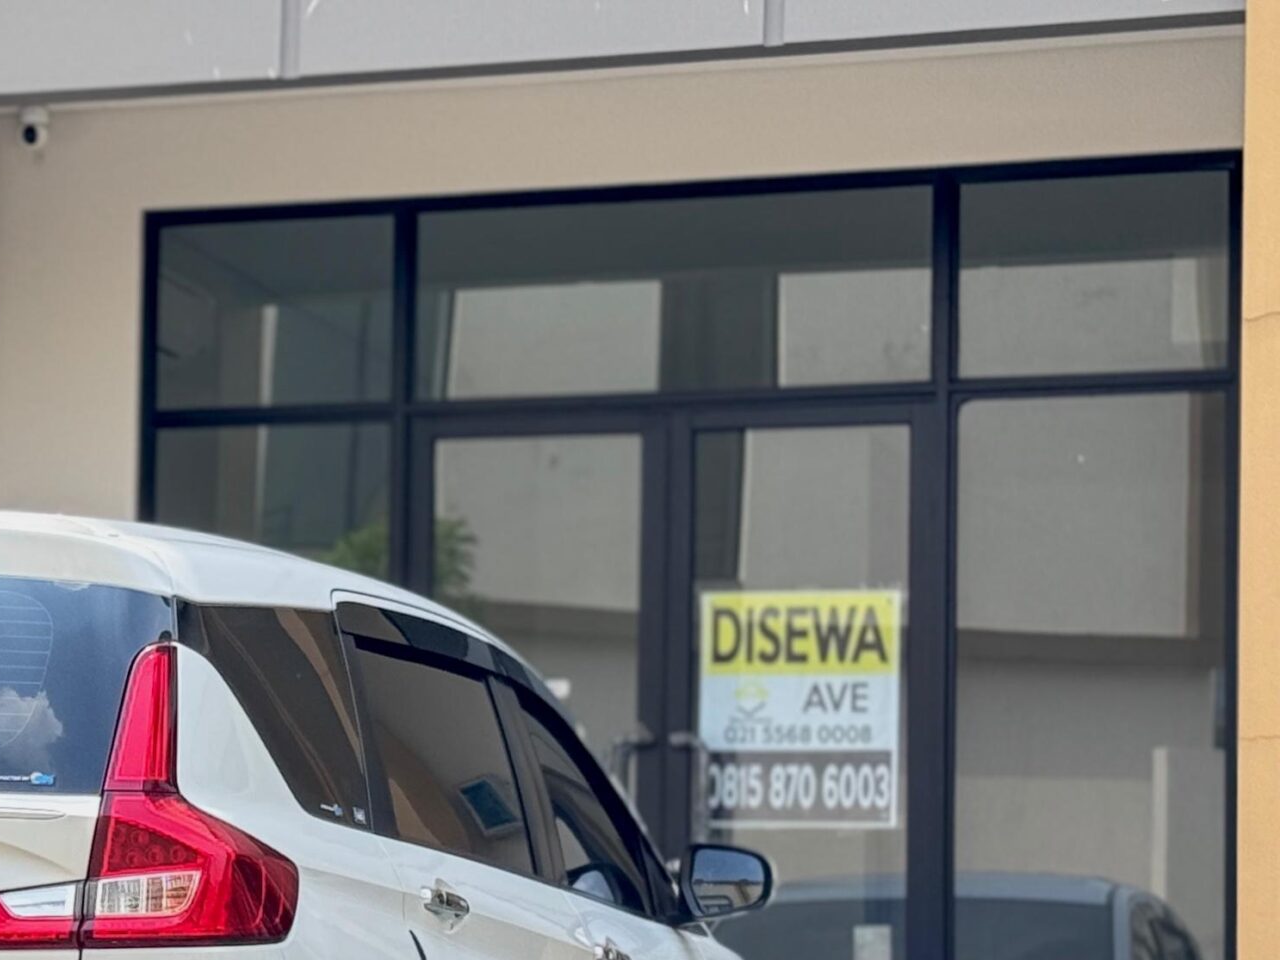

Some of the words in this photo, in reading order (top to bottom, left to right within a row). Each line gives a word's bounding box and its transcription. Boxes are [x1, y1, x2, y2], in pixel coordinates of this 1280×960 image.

[711, 605, 889, 664] DISEWA
[803, 682, 869, 714] AVE
[724, 725, 756, 744] 021
[763, 725, 812, 744] 5568
[817, 724, 872, 743] 0008
[708, 763, 763, 810] 0815
[769, 763, 816, 810] 870
[822, 763, 890, 810] 6003
